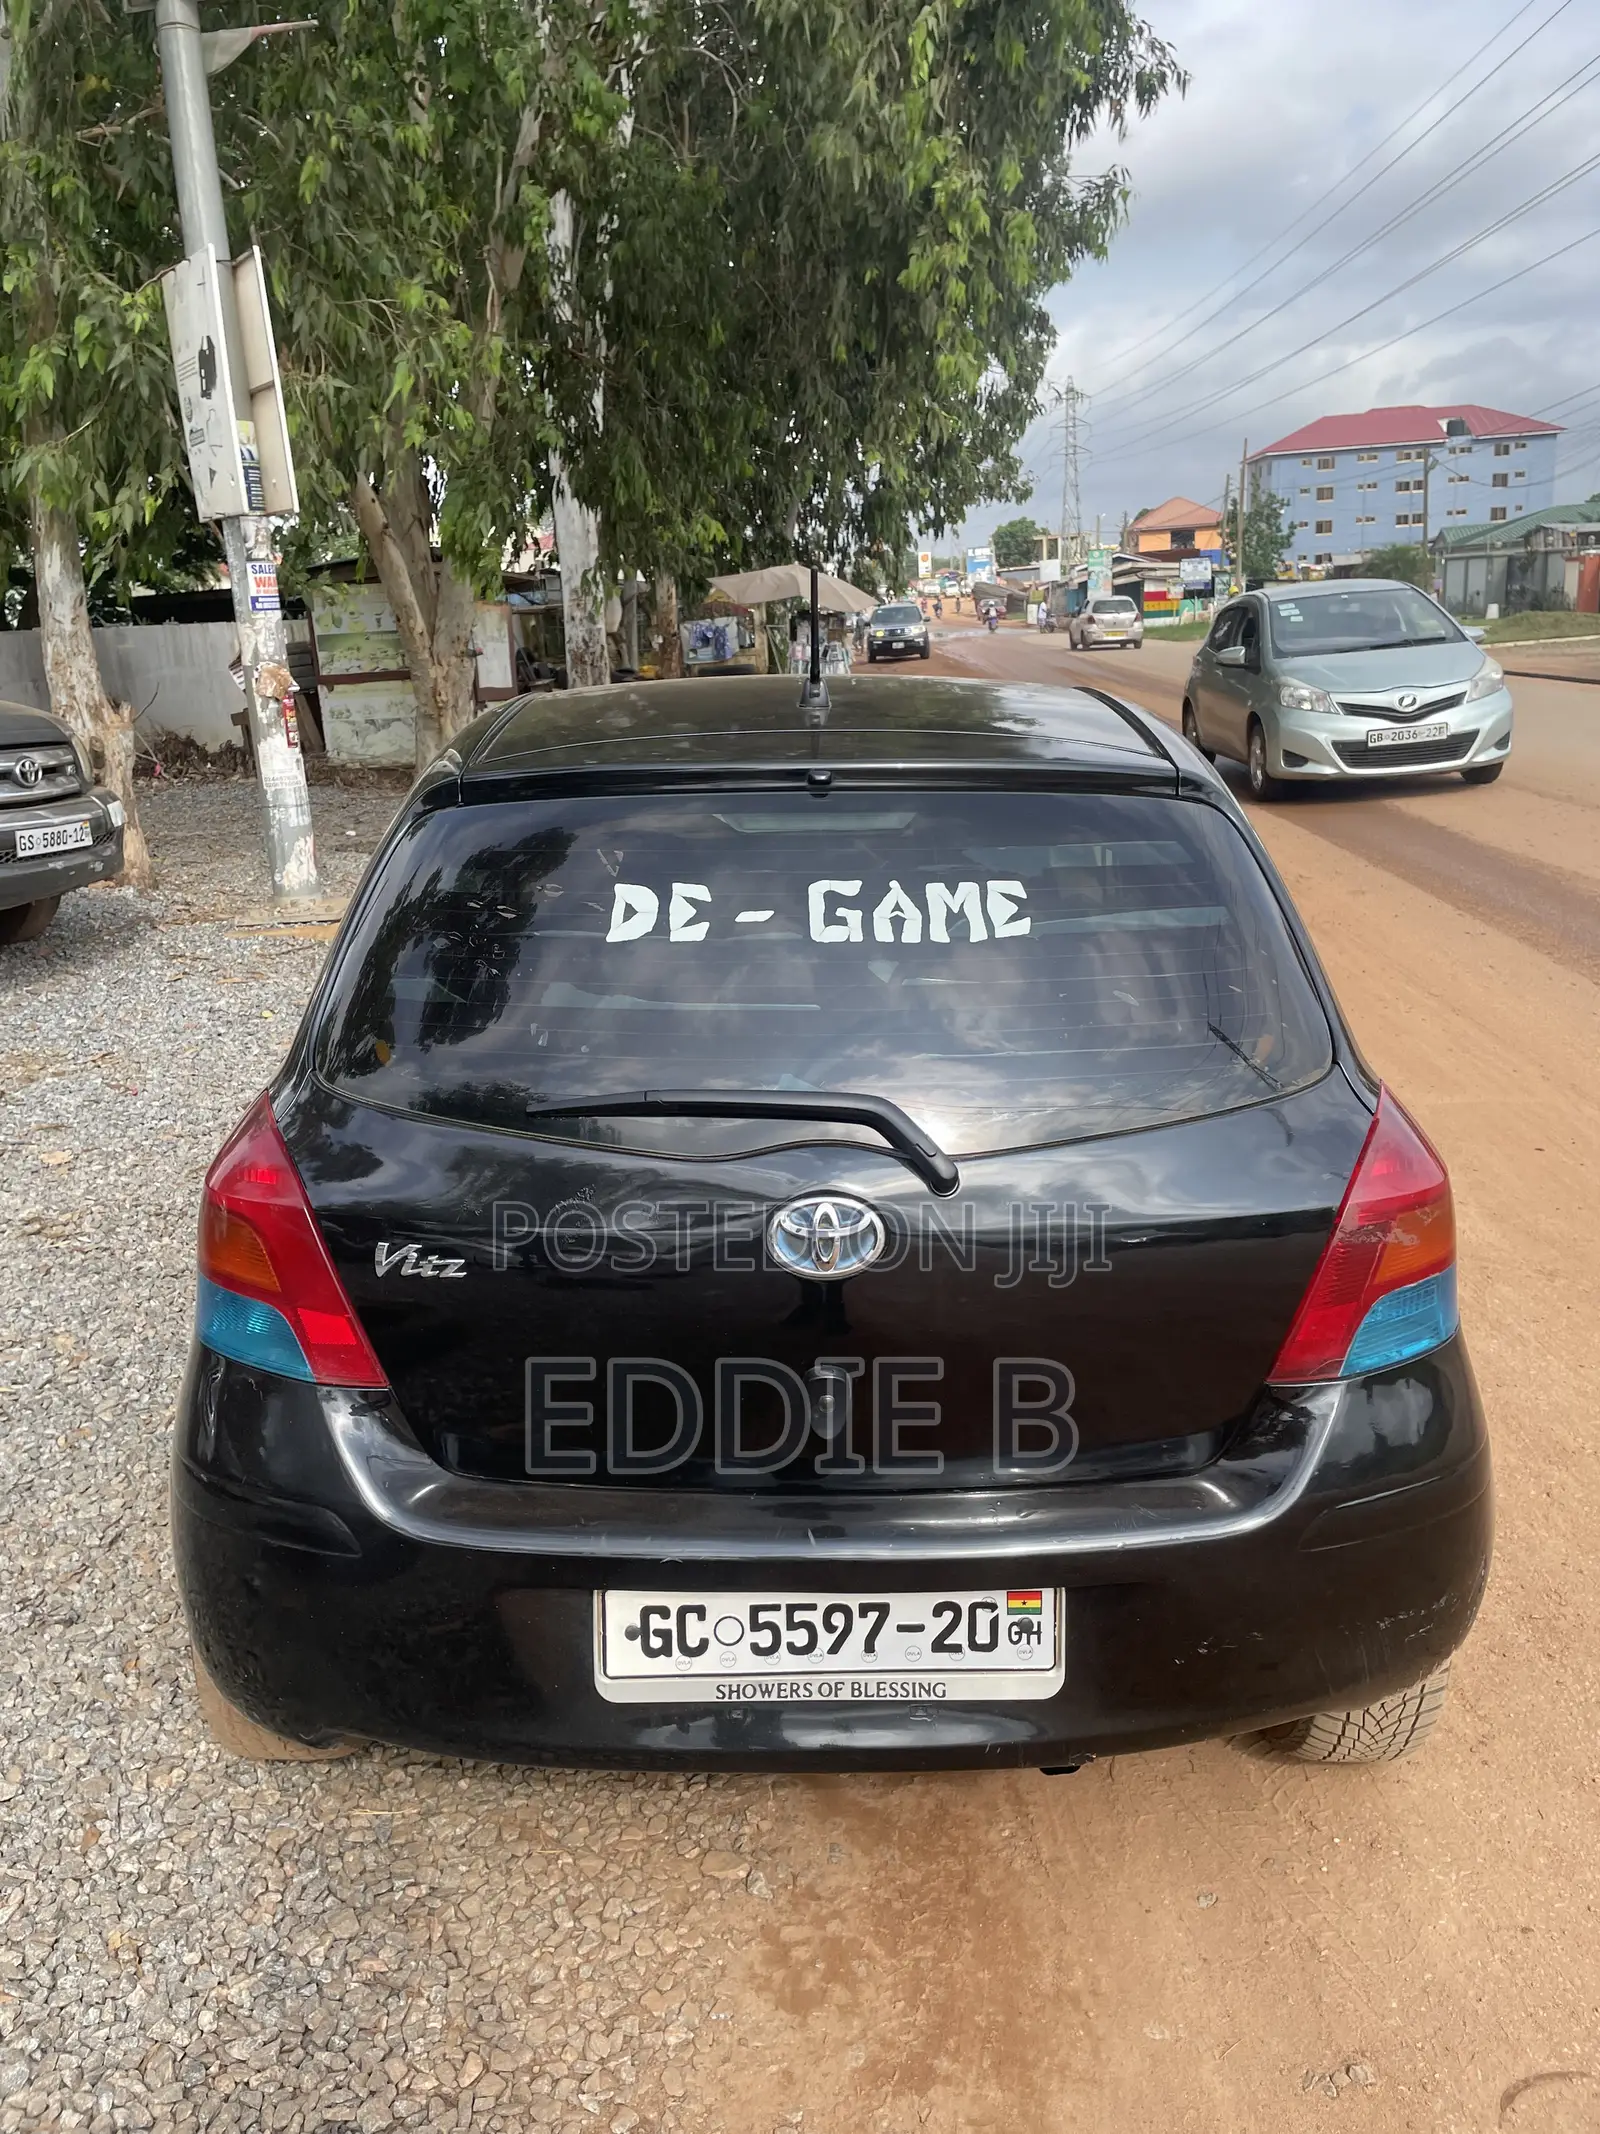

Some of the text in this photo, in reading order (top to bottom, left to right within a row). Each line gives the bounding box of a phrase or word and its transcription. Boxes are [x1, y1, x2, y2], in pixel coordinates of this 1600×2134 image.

[1370, 733, 1383, 744] GB
[19, 825, 85, 851] GS 5880-12
[606, 883, 712, 942] DE
[808, 880, 1031, 943] GAME
[374, 1242, 467, 1278] Vitz
[640, 1601, 998, 1659] GC 5597-20
[1008, 1620, 1042, 1646] GH
[715, 1681, 947, 1700] SHOWERS OF BLESSING
